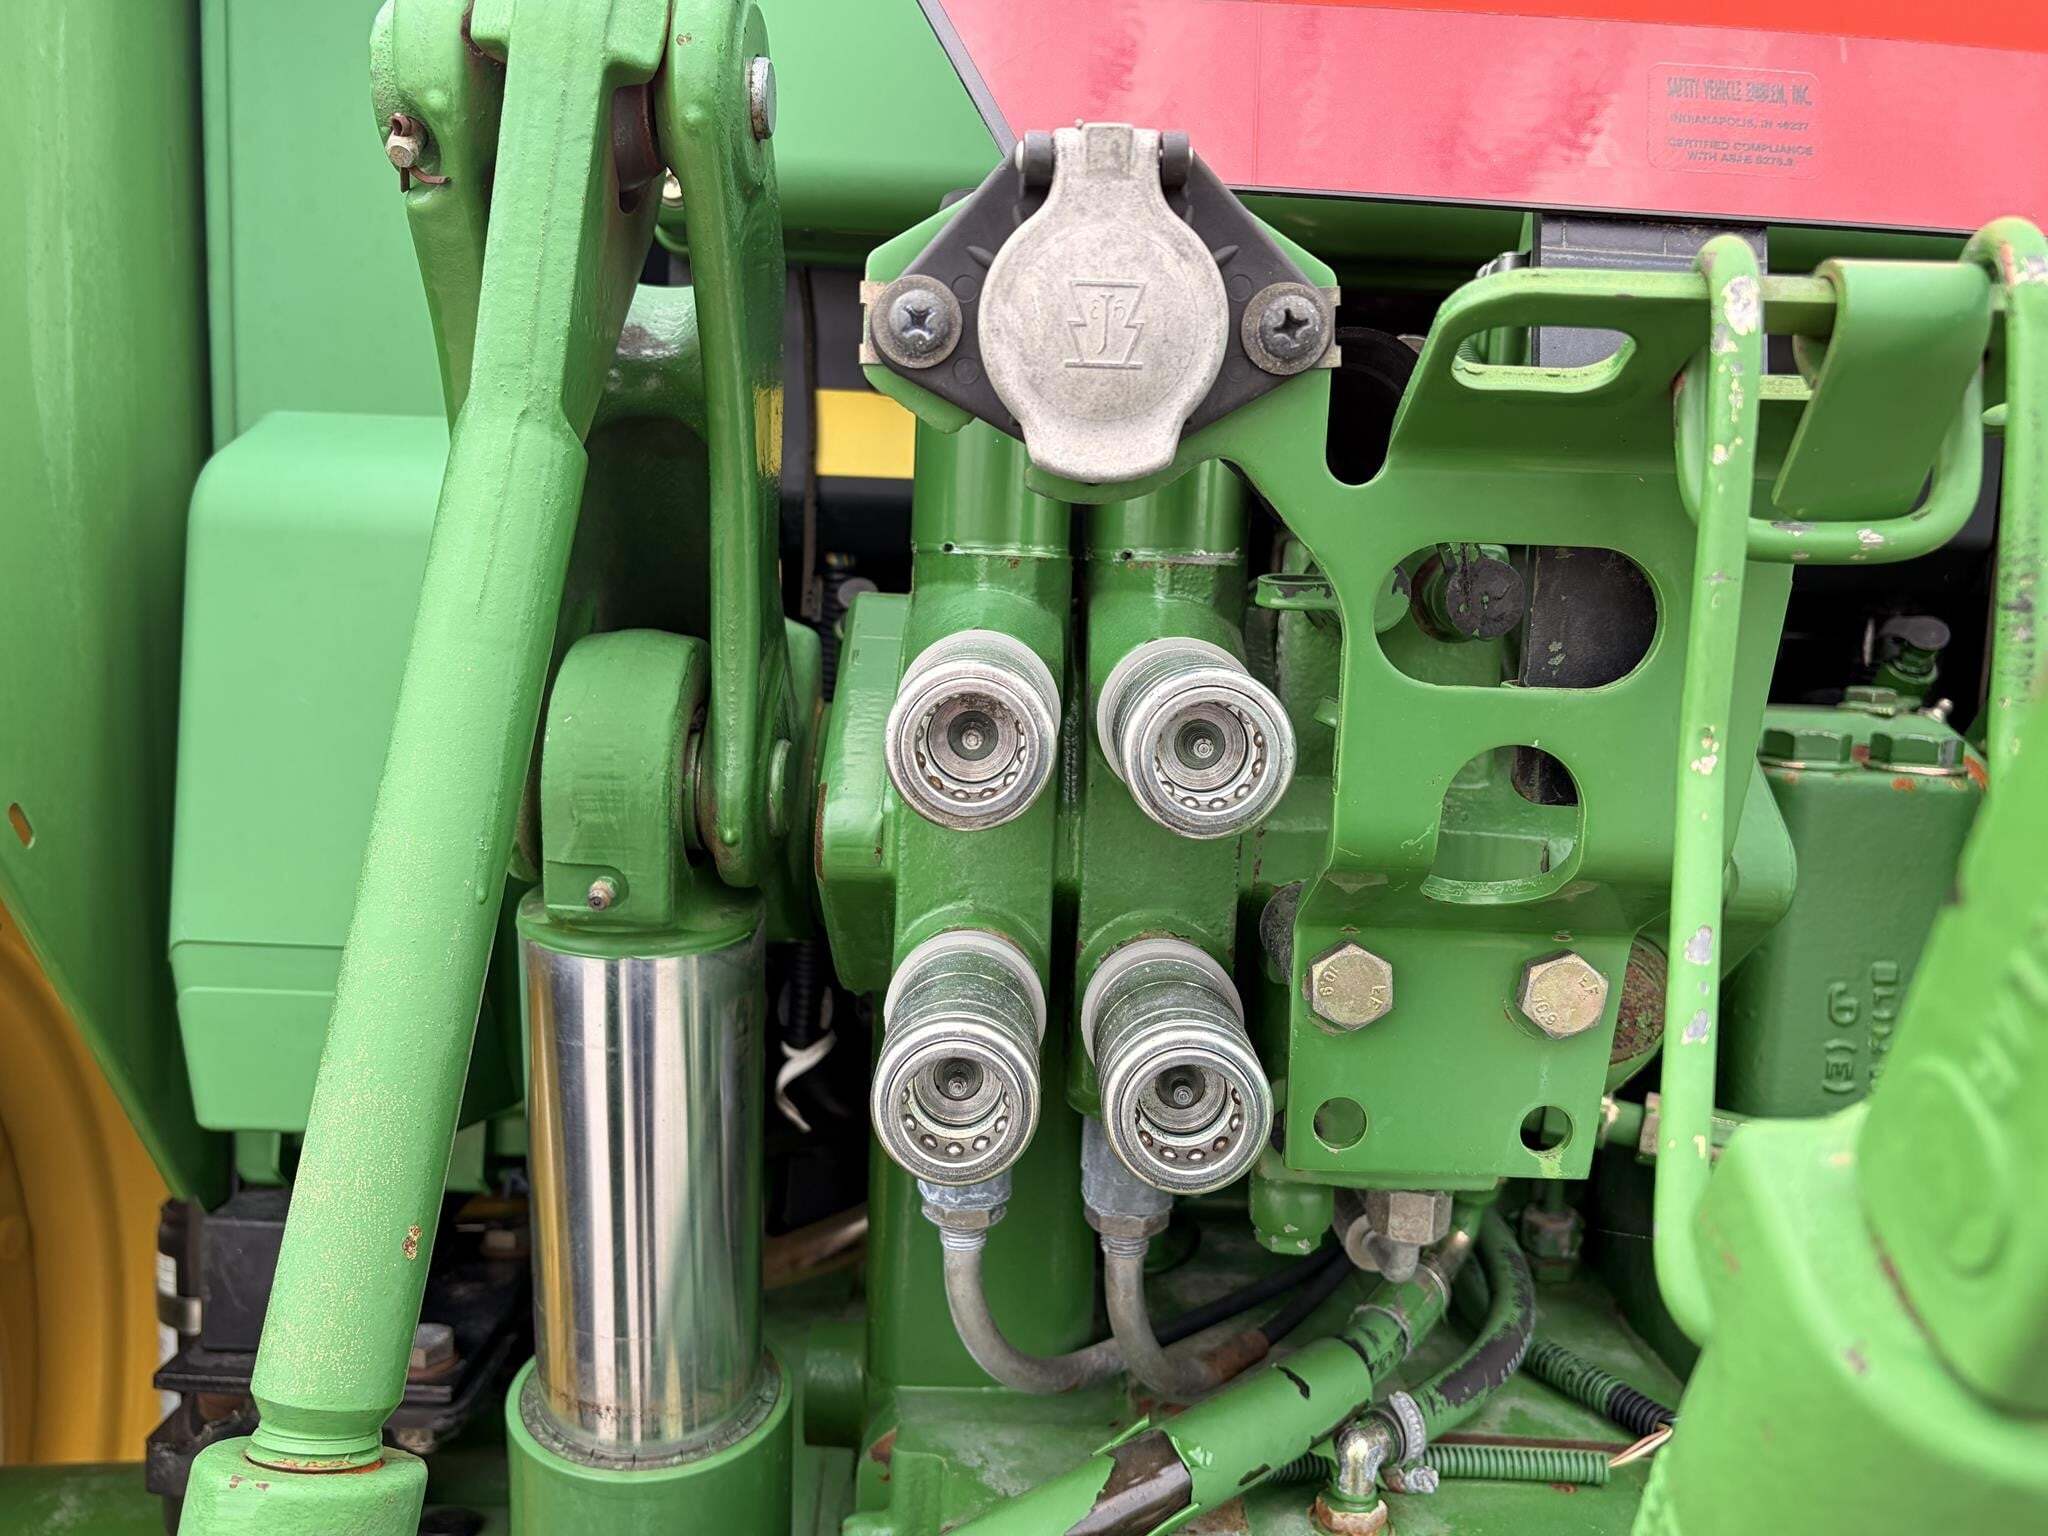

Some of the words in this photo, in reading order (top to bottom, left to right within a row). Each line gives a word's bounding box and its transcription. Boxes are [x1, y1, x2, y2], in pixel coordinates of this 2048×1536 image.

[1703, 79, 1742, 102] VEHICLE
[1733, 142, 1814, 156] COMPLIANCE
[1688, 151, 1717, 162] WITH
